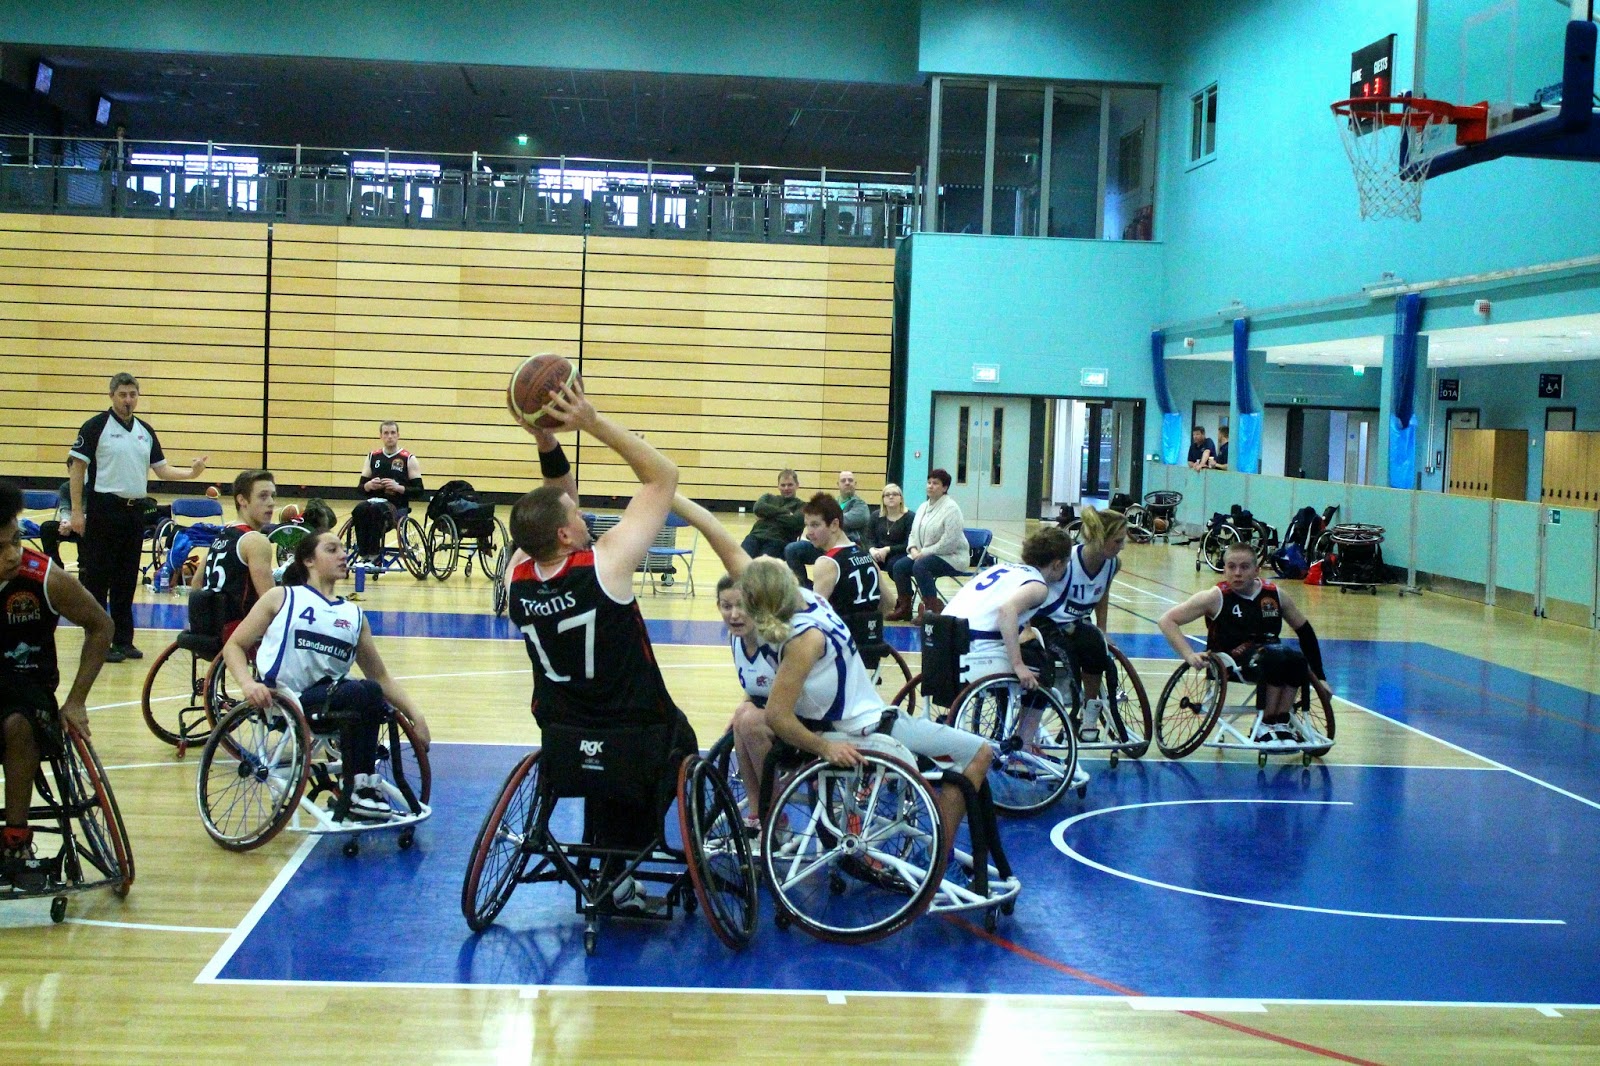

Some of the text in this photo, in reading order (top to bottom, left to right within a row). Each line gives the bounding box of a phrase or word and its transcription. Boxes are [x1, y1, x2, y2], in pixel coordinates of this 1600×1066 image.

[374, 460, 381, 468] 8
[848, 554, 874, 567] Titans
[848, 566, 881, 604] 12
[975, 568, 1009, 591] 5
[1072, 584, 1085, 600] 11
[520, 591, 576, 616] Titans
[1232, 604, 1243, 618] 4
[6, 608, 41, 624] TITANS
[299, 606, 317, 625] 4
[297, 638, 348, 658] Standard Life
[520, 608, 597, 682] 17
